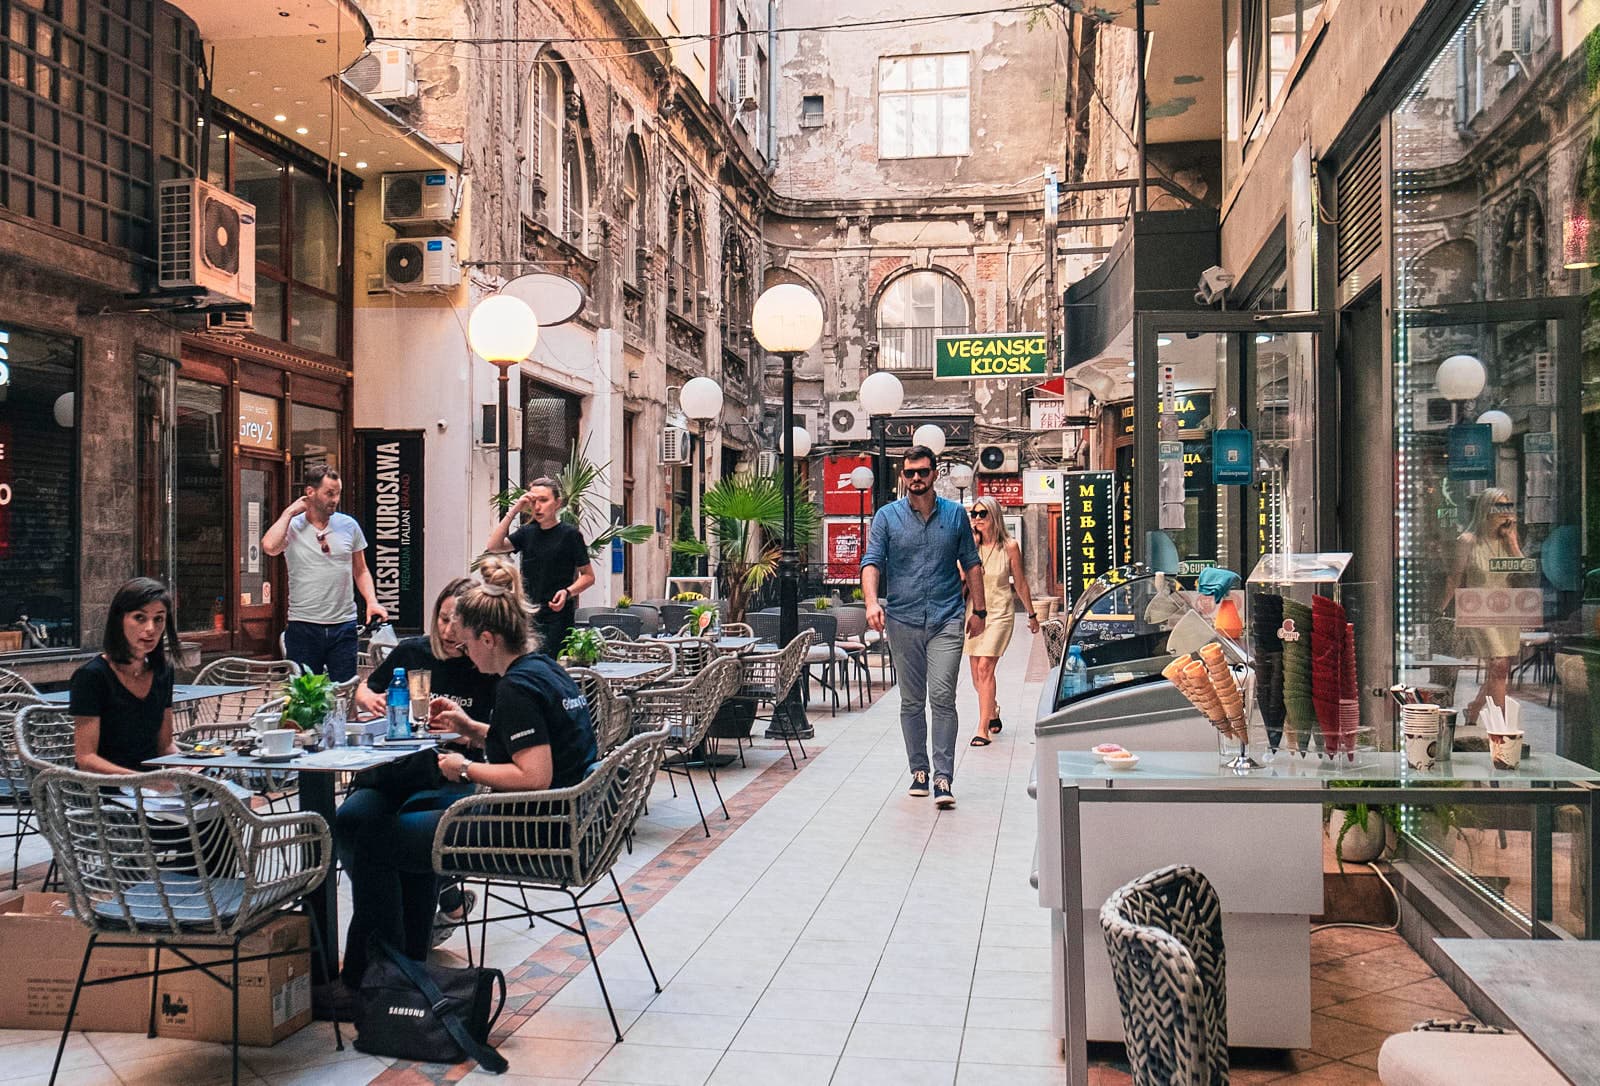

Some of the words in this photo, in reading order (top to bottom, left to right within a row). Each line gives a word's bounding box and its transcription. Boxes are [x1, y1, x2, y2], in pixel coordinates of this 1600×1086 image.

[946, 339, 1046, 357] VEGANSKI
[971, 356, 1031, 374] KIOSK
[266, 421, 273, 440] 2
[376, 441, 400, 539] KUROSAWA
[402, 473, 411, 508] BRAND
[402, 509, 411, 545] ITALIAN
[402, 547, 411, 591] PREMIUM
[388, 1005, 425, 1018] SAMSUNG
